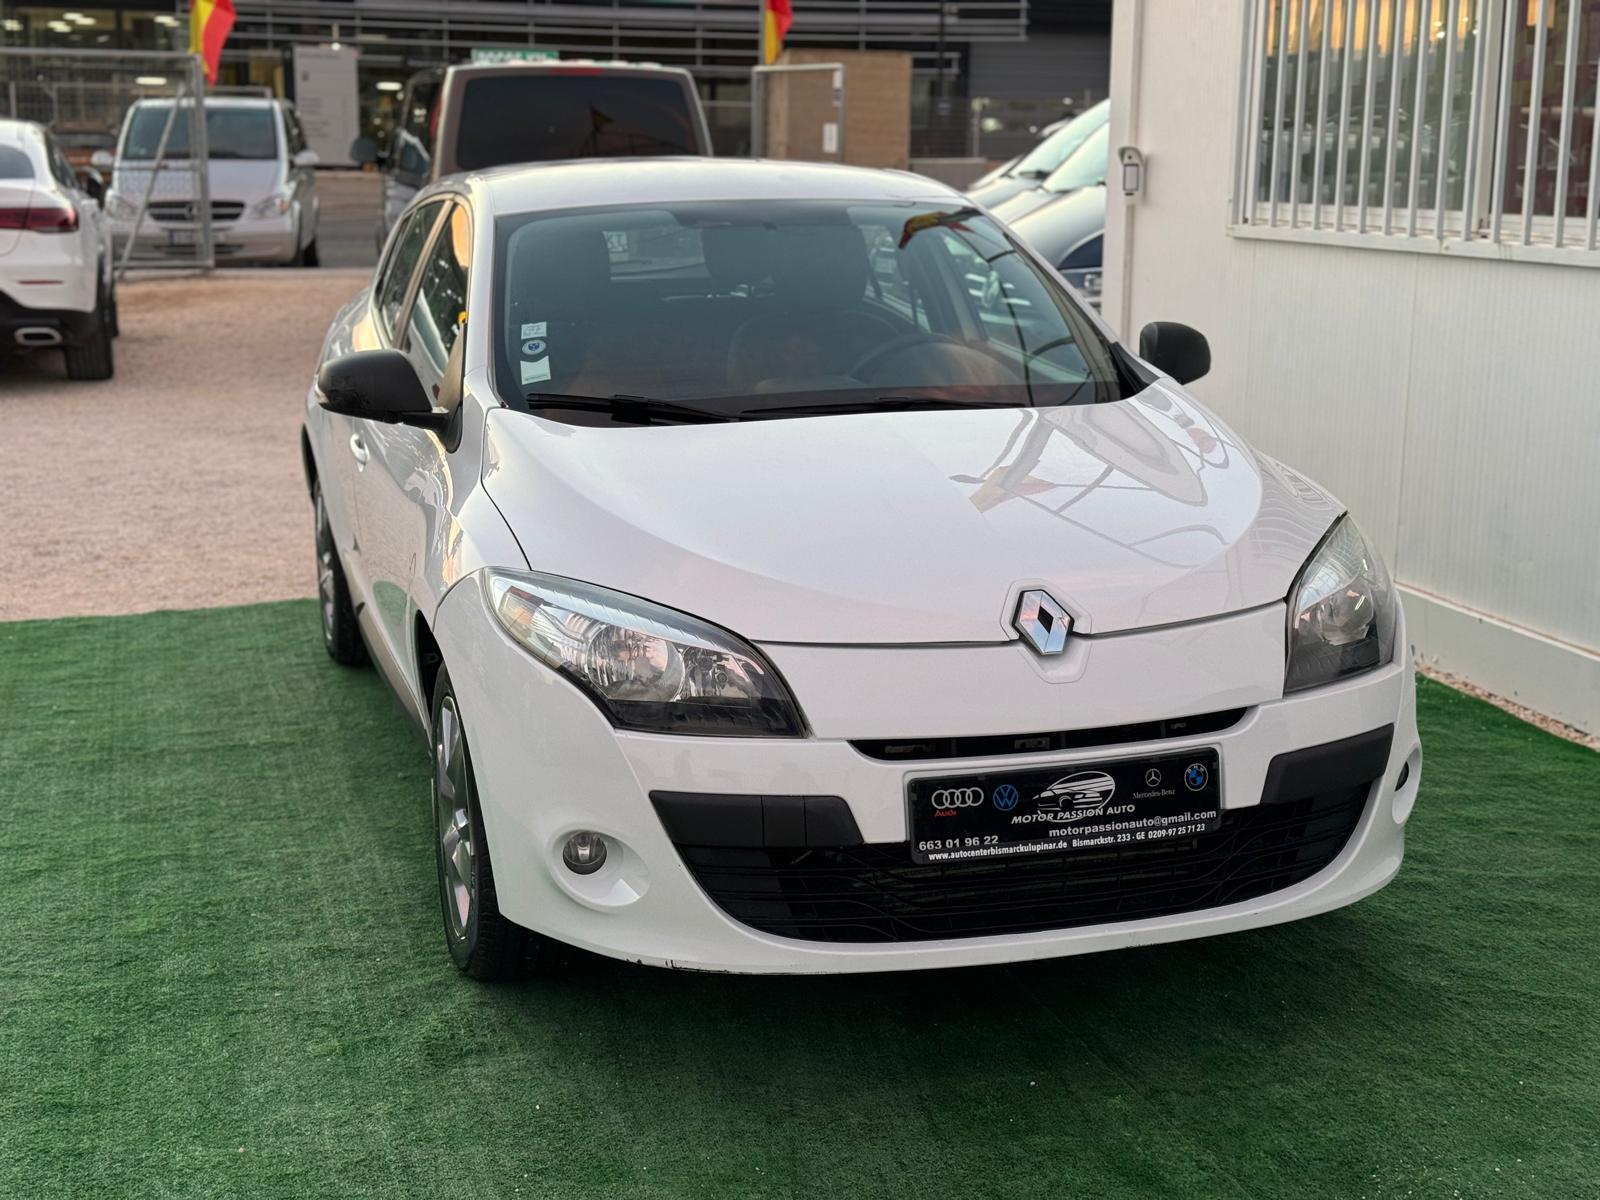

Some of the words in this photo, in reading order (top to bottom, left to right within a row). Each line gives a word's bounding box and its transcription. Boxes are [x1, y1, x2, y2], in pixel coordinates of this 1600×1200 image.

[1132, 788, 1176, 800] Mercedes-Benz
[934, 809, 957, 817] Audi
[1011, 812, 1054, 825] MOTOR
[1057, 807, 1104, 820] PASSION
[1106, 804, 1136, 815] AUTO
[1048, 810, 1217, 838] motorpassionauto@gmail.com
[919, 840, 942, 851] 663
[946, 838, 960, 849] 01
[964, 836, 980, 847] 96
[984, 834, 999, 845] 22
[1072, 834, 1116, 848] Bismarckstr.
[1117, 833, 1131, 843] 233
[1136, 831, 1146, 841] GE
[1147, 827, 1177, 839] 0209-97
[1178, 826, 1187, 836] 25
[1187, 825, 1196, 834] 71
[1196, 823, 1206, 833] 23
